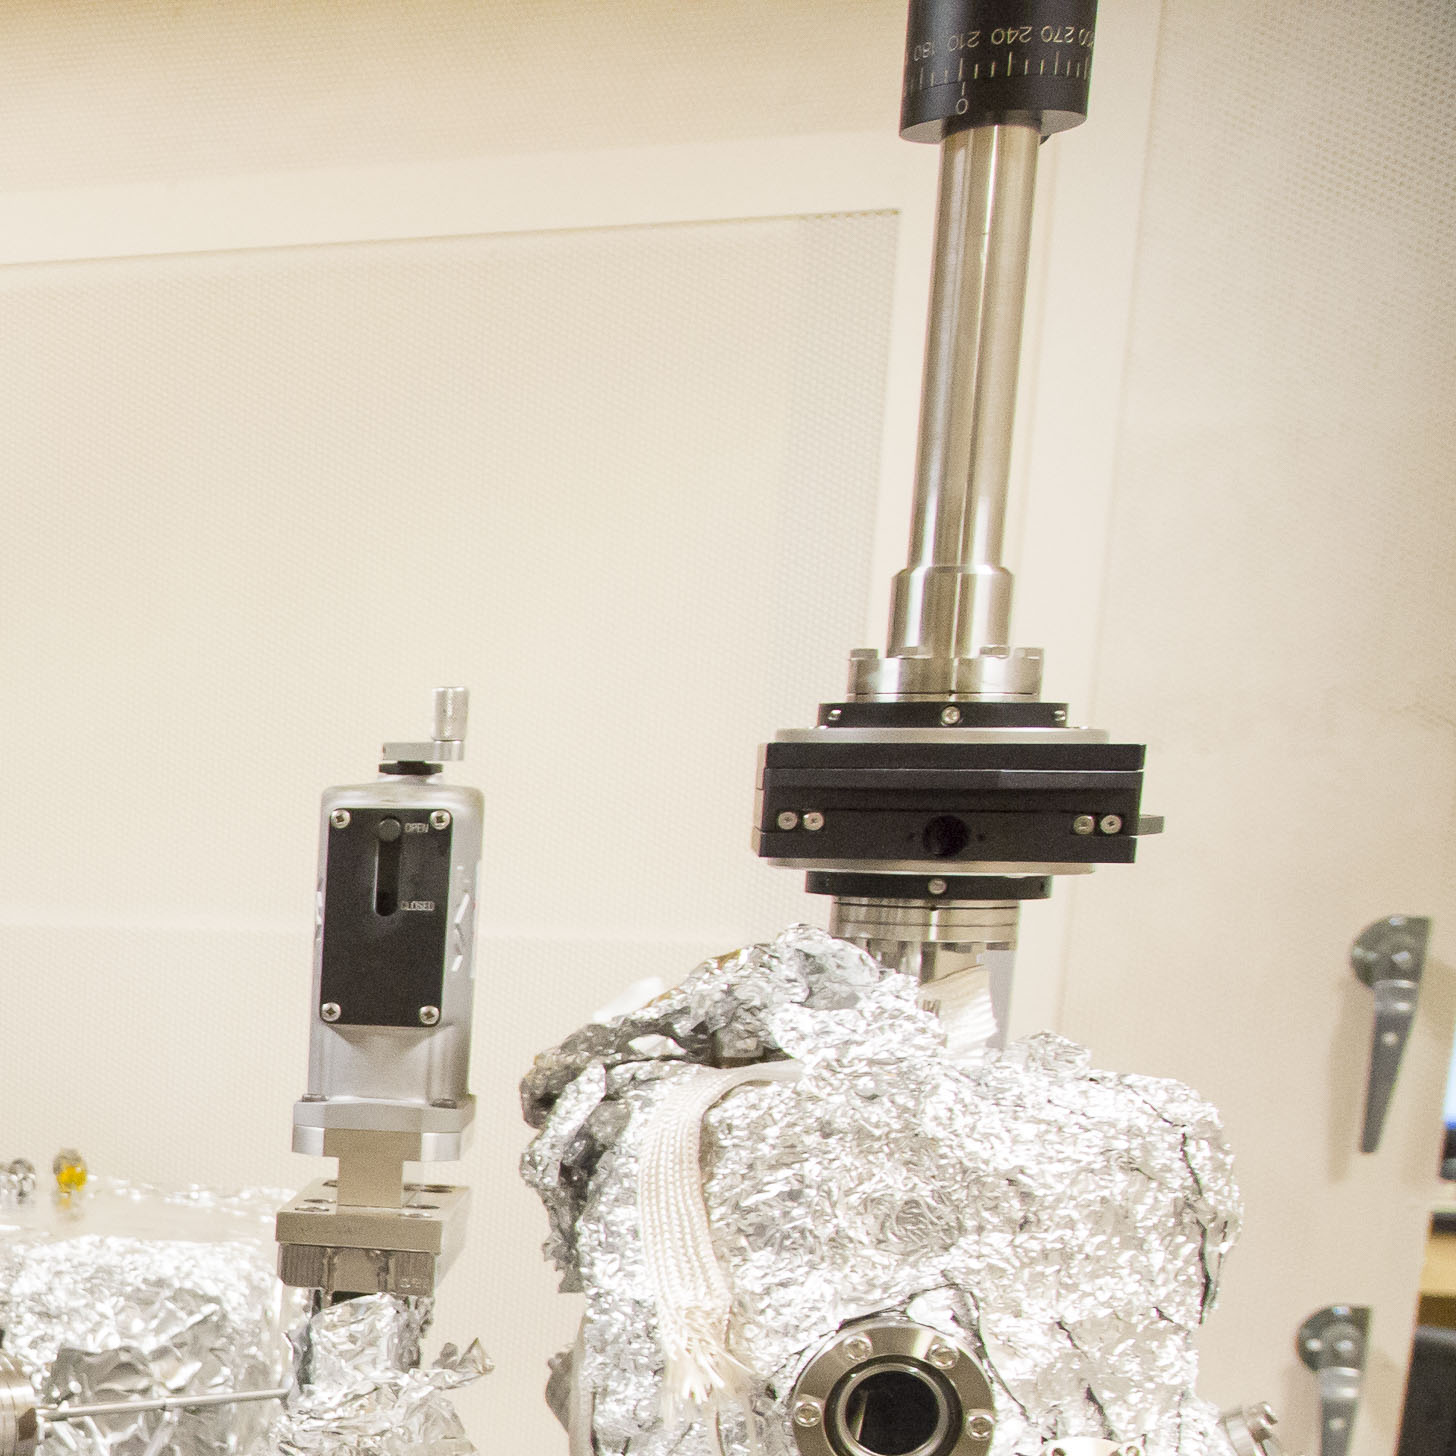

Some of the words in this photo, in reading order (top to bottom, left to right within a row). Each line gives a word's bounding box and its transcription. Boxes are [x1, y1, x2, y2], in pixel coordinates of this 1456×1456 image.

[949, 31, 980, 52] 210
[991, 26, 1033, 45] 240
[1041, 25, 1074, 43] 270
[404, 822, 430, 833] OPEN
[400, 900, 436, 911] CLOSED
